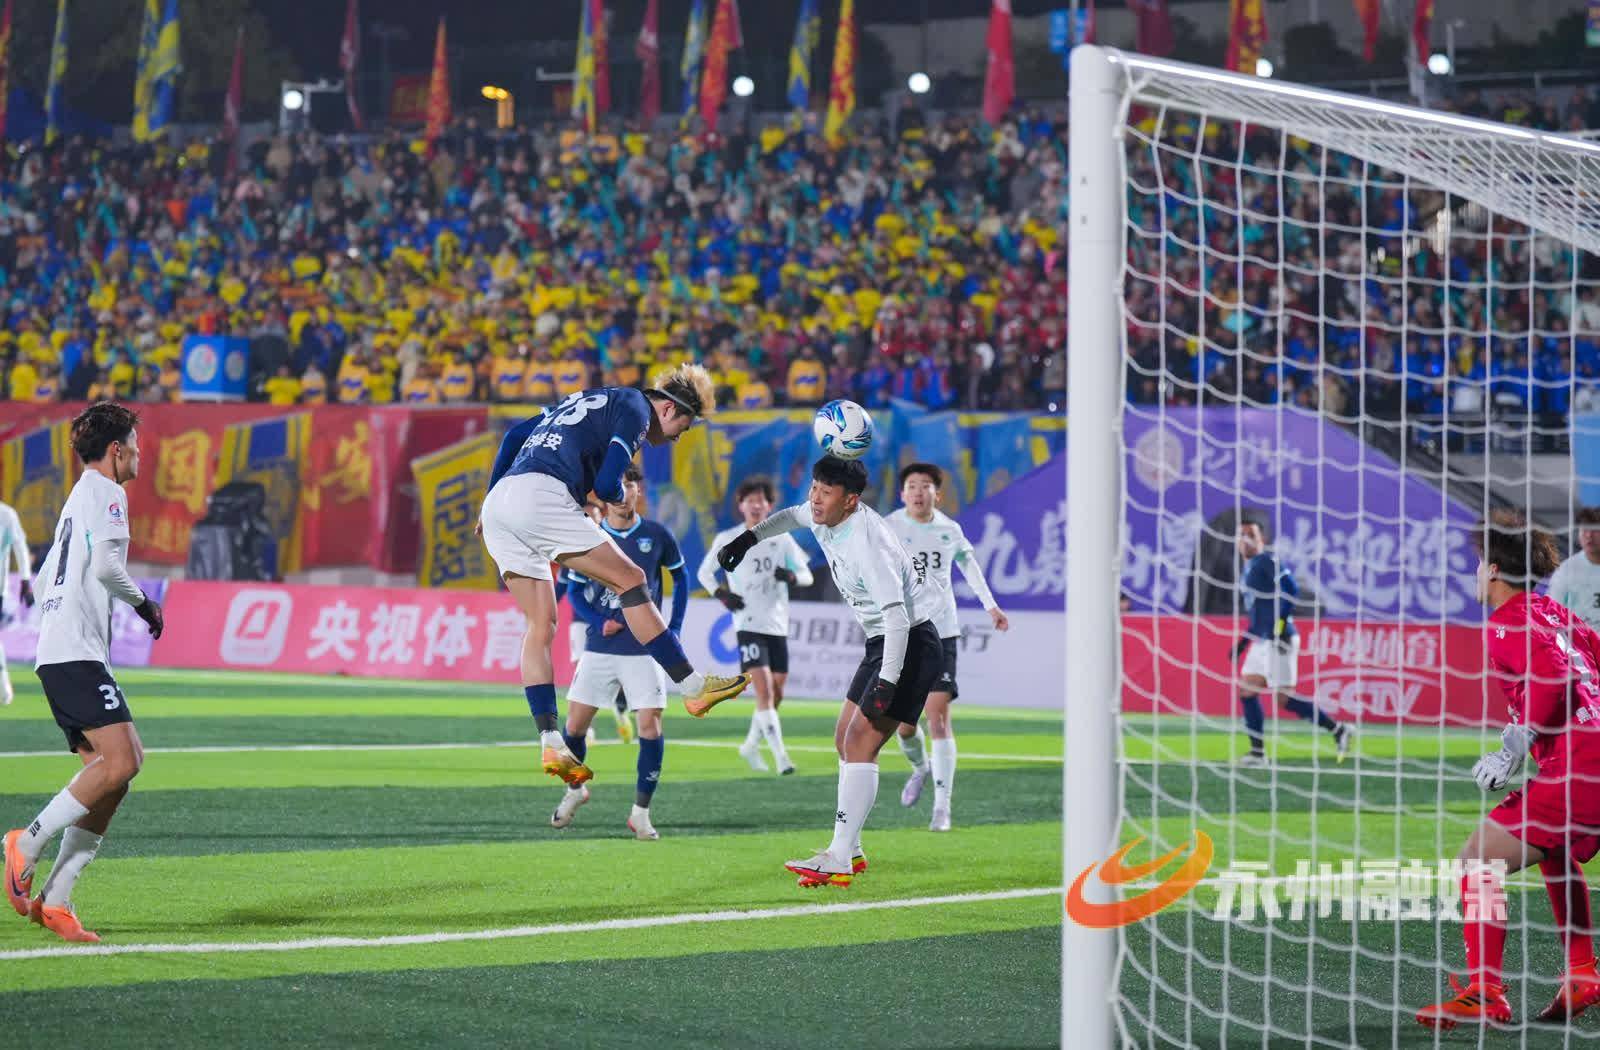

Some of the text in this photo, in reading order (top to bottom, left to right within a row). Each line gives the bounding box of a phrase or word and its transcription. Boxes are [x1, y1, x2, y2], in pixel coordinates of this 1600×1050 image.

[754, 557, 773, 573] 20
[306, 600, 527, 671] 央视体育
[740, 643, 760, 663] 20
